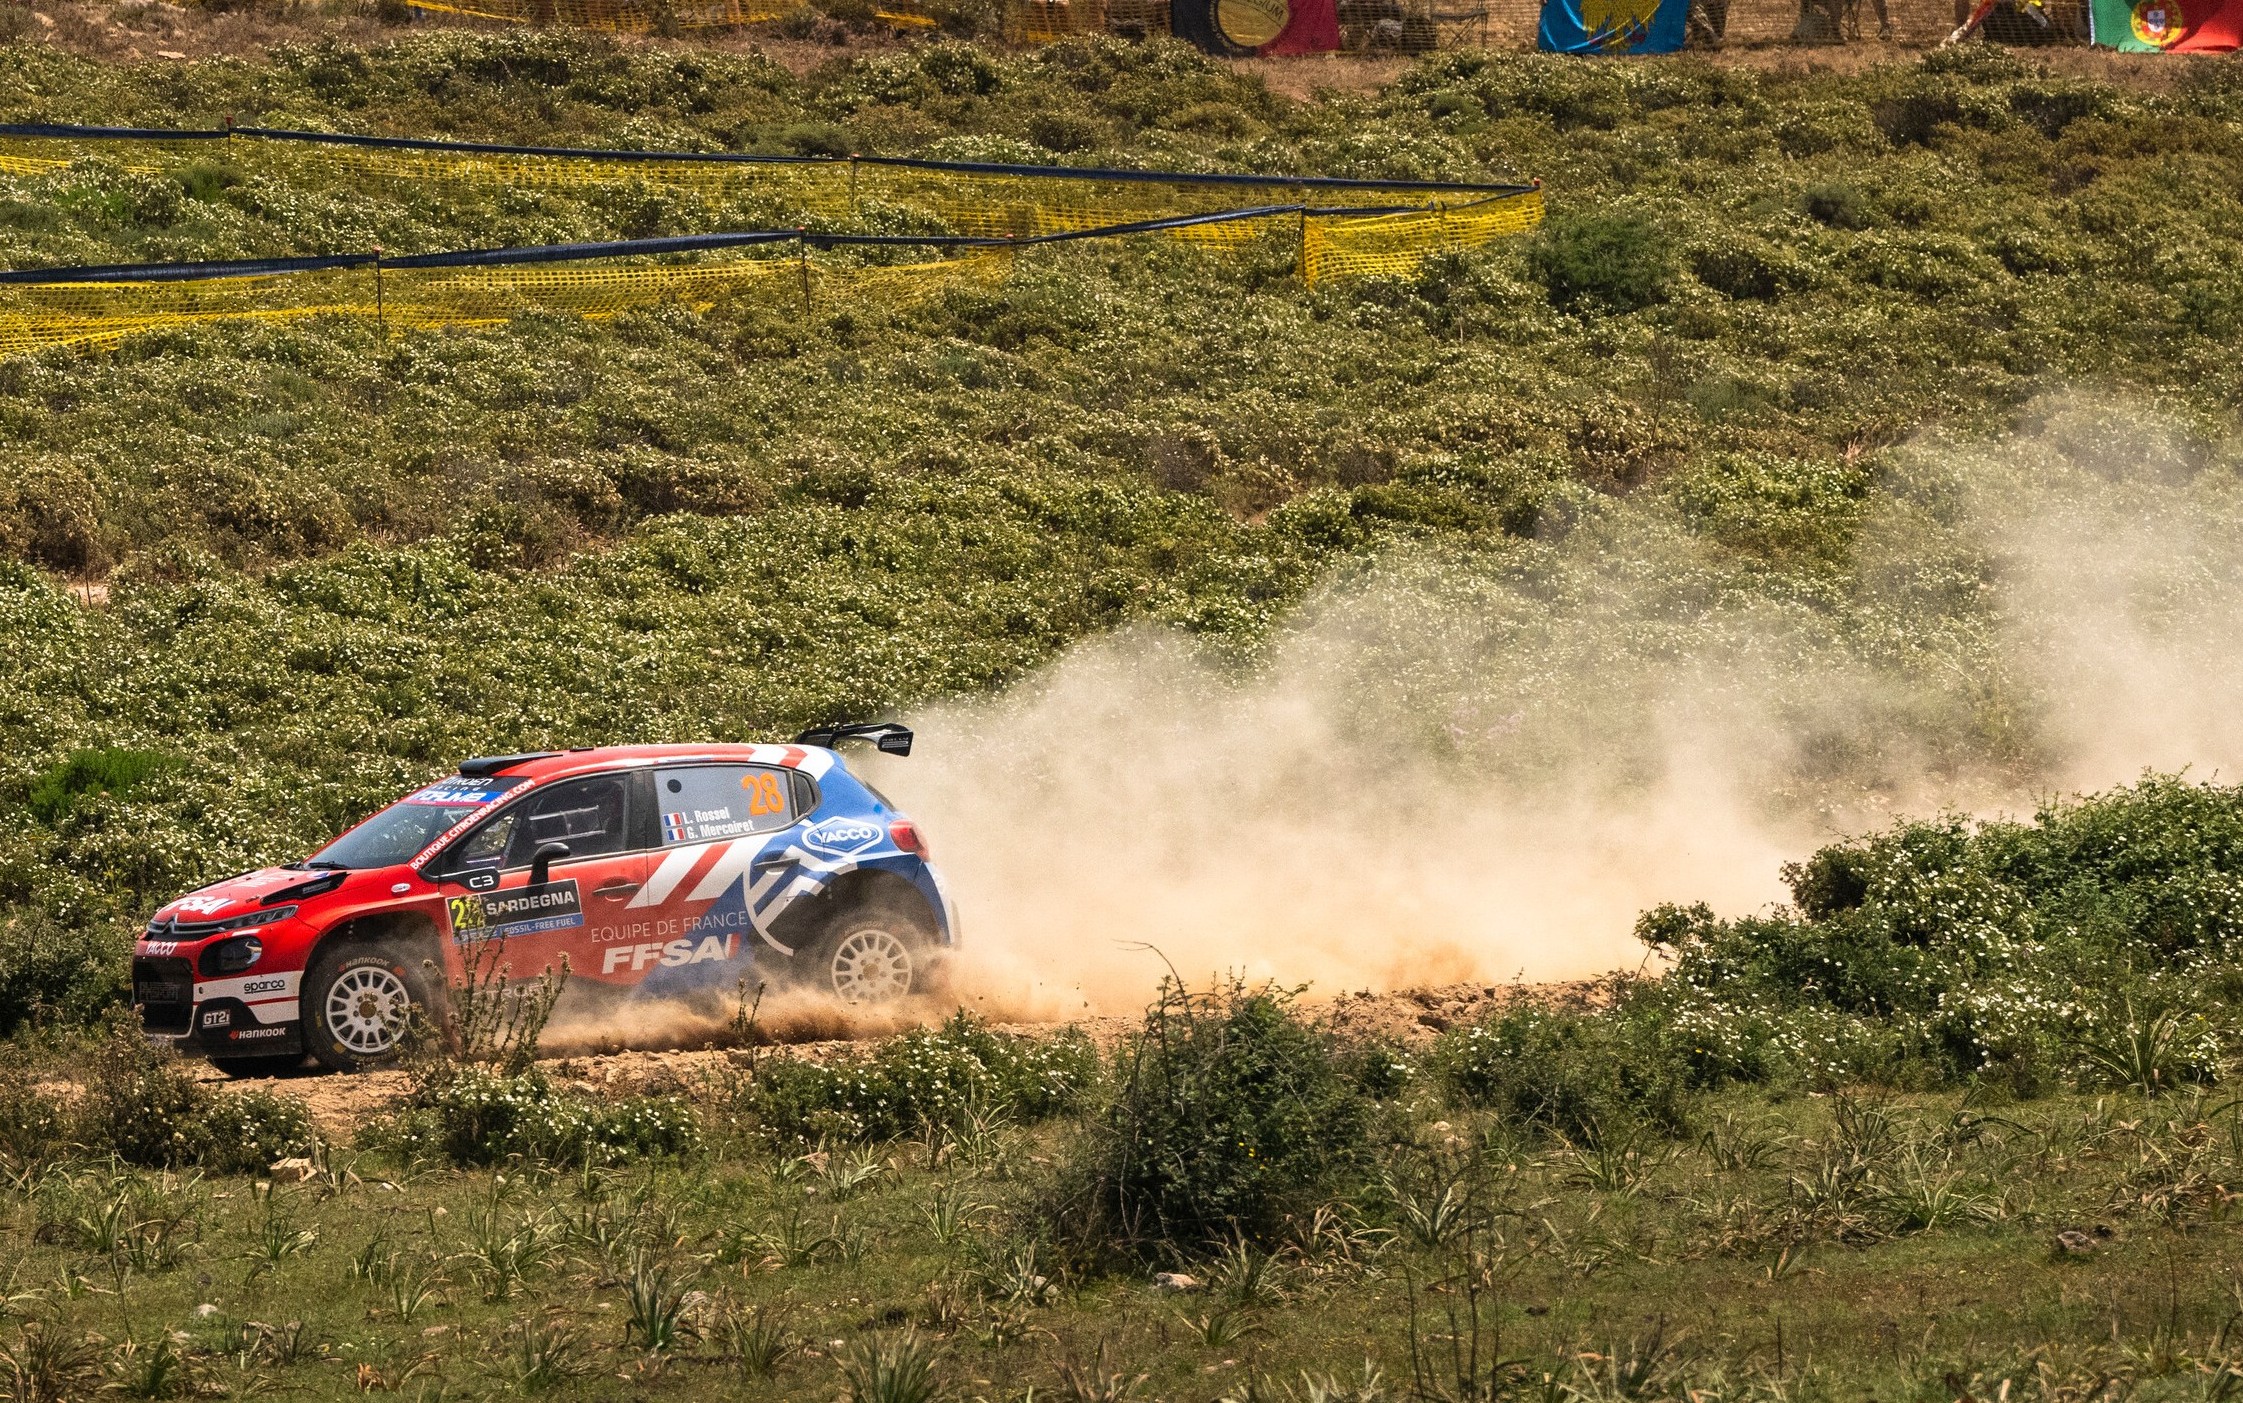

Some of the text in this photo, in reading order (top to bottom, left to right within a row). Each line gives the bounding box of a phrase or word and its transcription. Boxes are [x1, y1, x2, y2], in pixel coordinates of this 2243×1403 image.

[741, 771, 785, 816] 28
[682, 806, 731, 825] L. Rossel
[686, 820, 755, 839] G. Mercoiret
[814, 828, 873, 843] YACCO
[469, 873, 495, 889] C3
[486, 890, 575, 916] SARDEGNA
[555, 917, 577, 928] FUEL
[591, 911, 748, 943] EQUIPE DE FRANCE
[145, 941, 179, 956] YACCO
[244, 979, 286, 994] sparco
